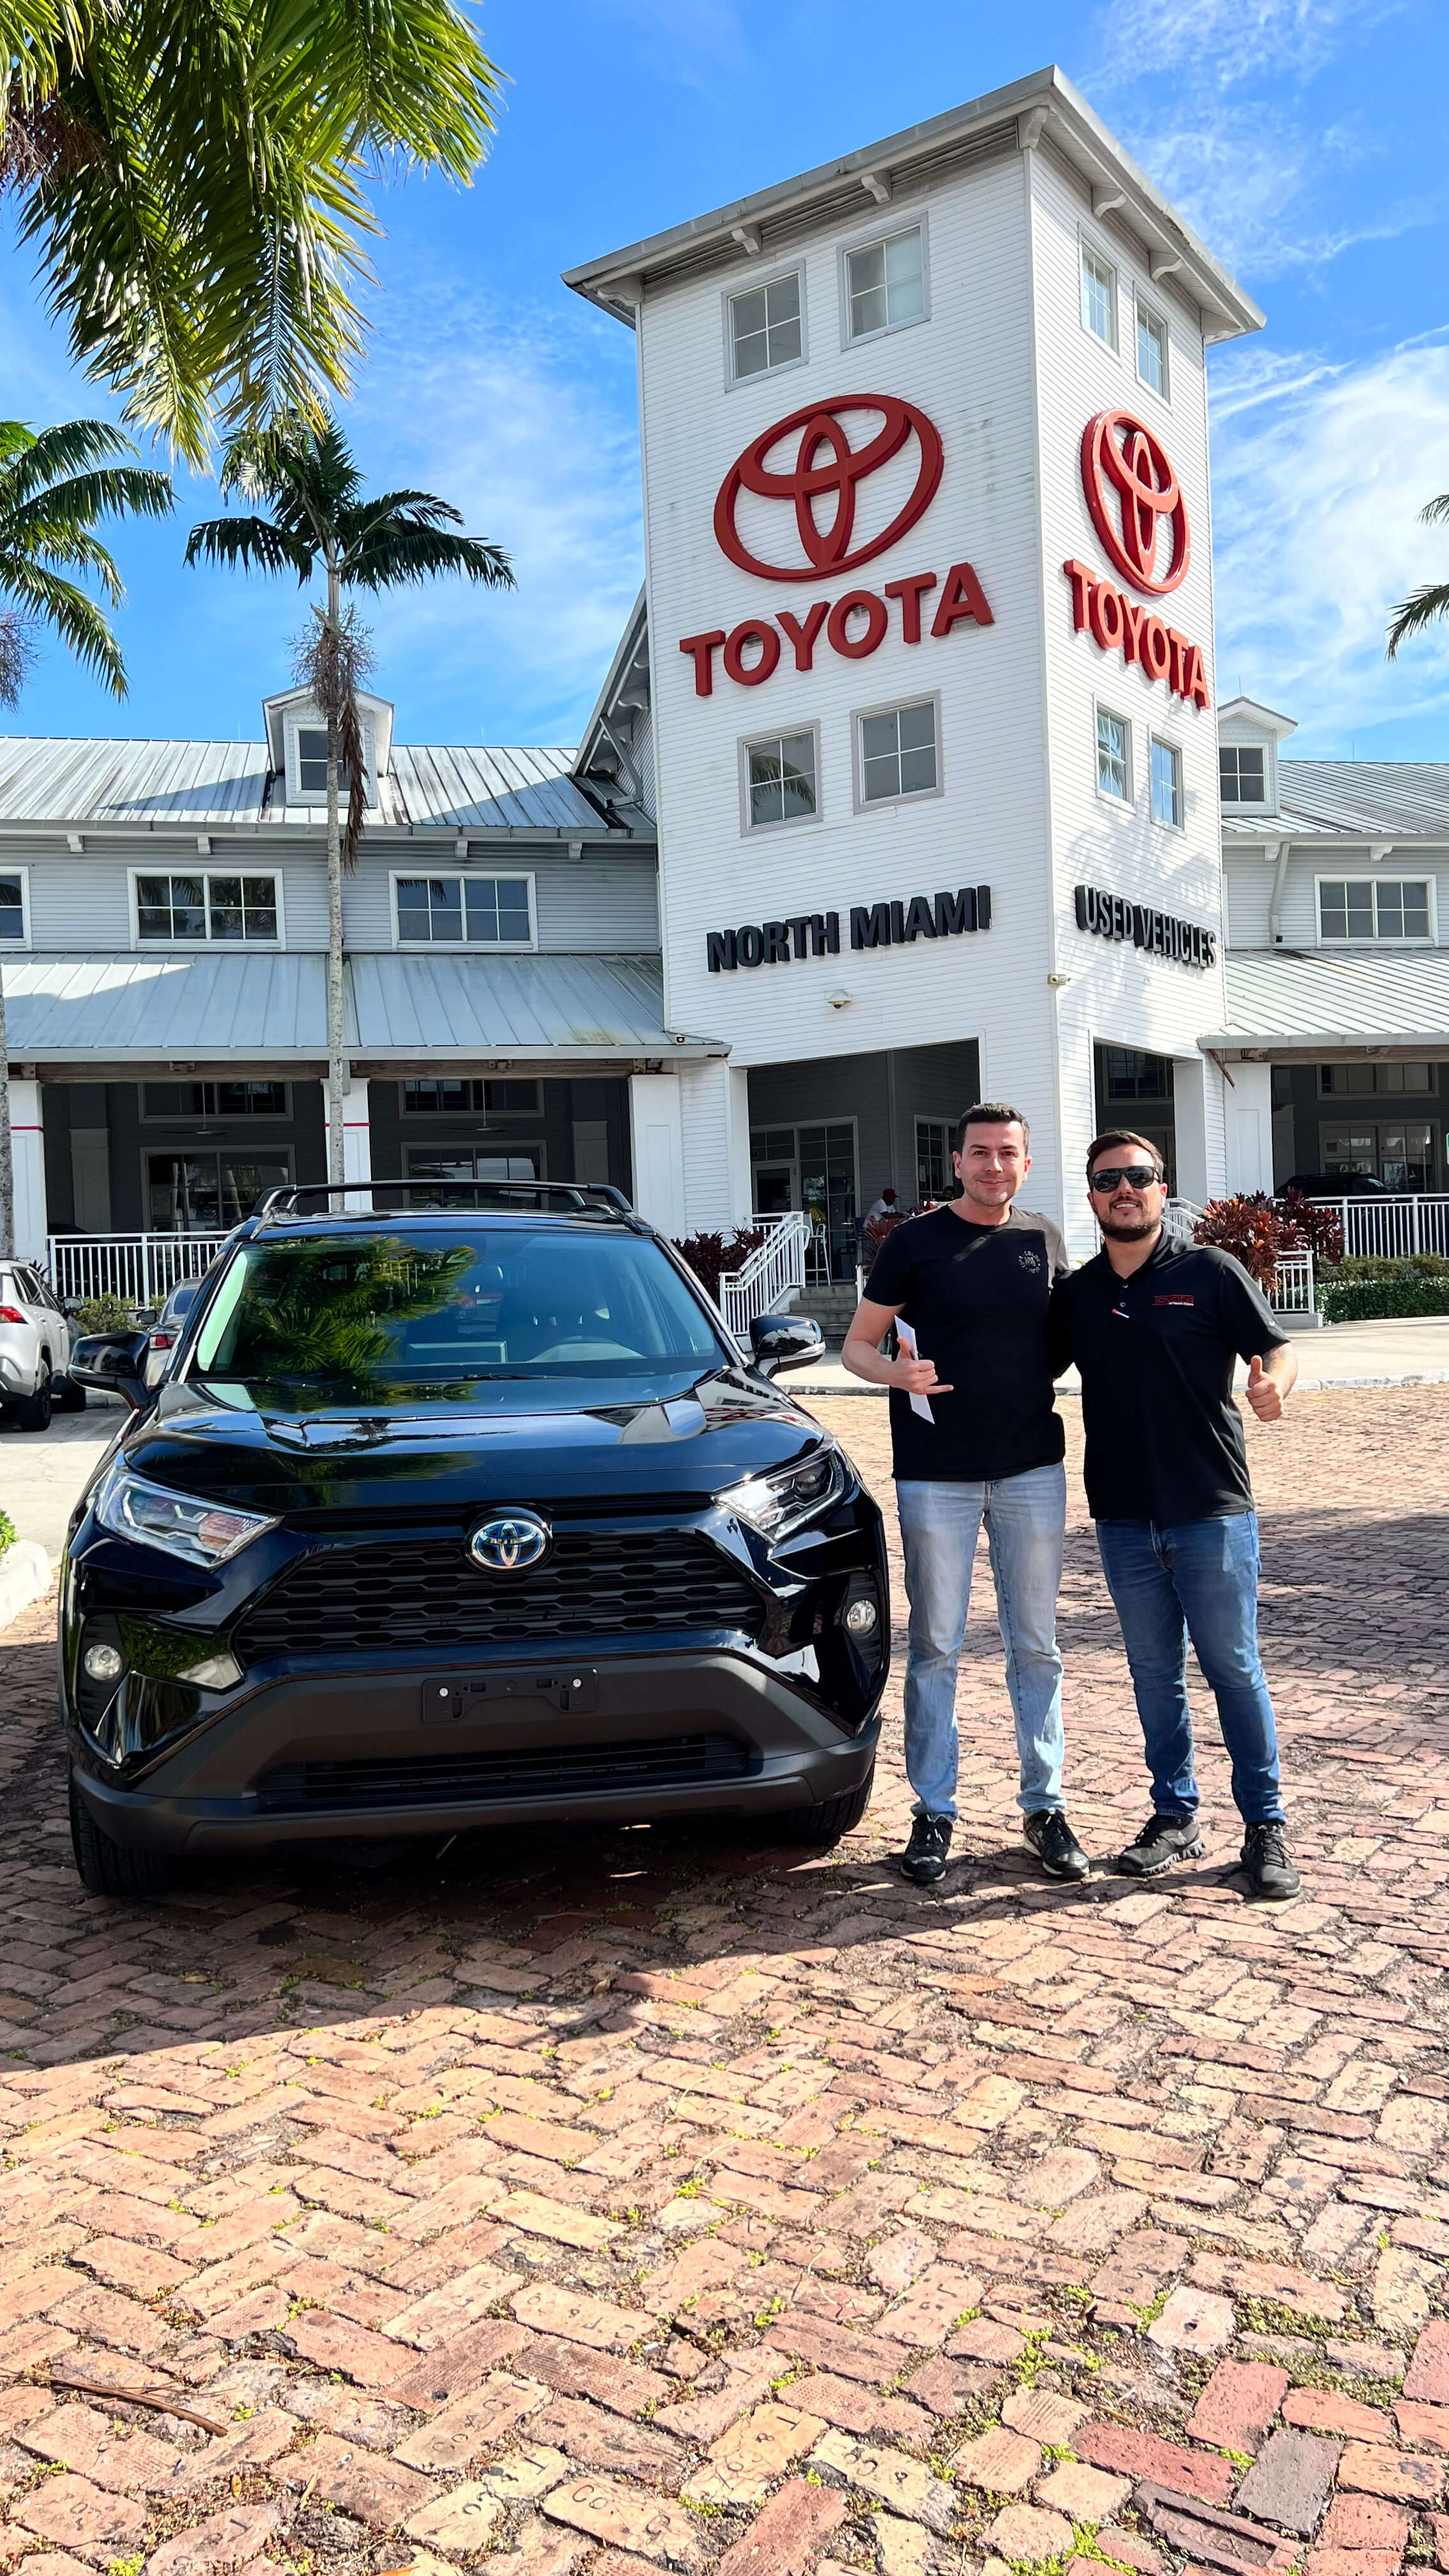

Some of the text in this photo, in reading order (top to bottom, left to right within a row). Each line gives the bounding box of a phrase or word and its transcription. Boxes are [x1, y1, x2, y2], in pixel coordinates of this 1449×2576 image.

[680, 562, 994, 697] TOYOTA
[1064, 558, 1211, 709] TOYOTA
[707, 885, 991, 972] NORTH MIAMI
[1075, 885, 1216, 969] USED VEHICLES
